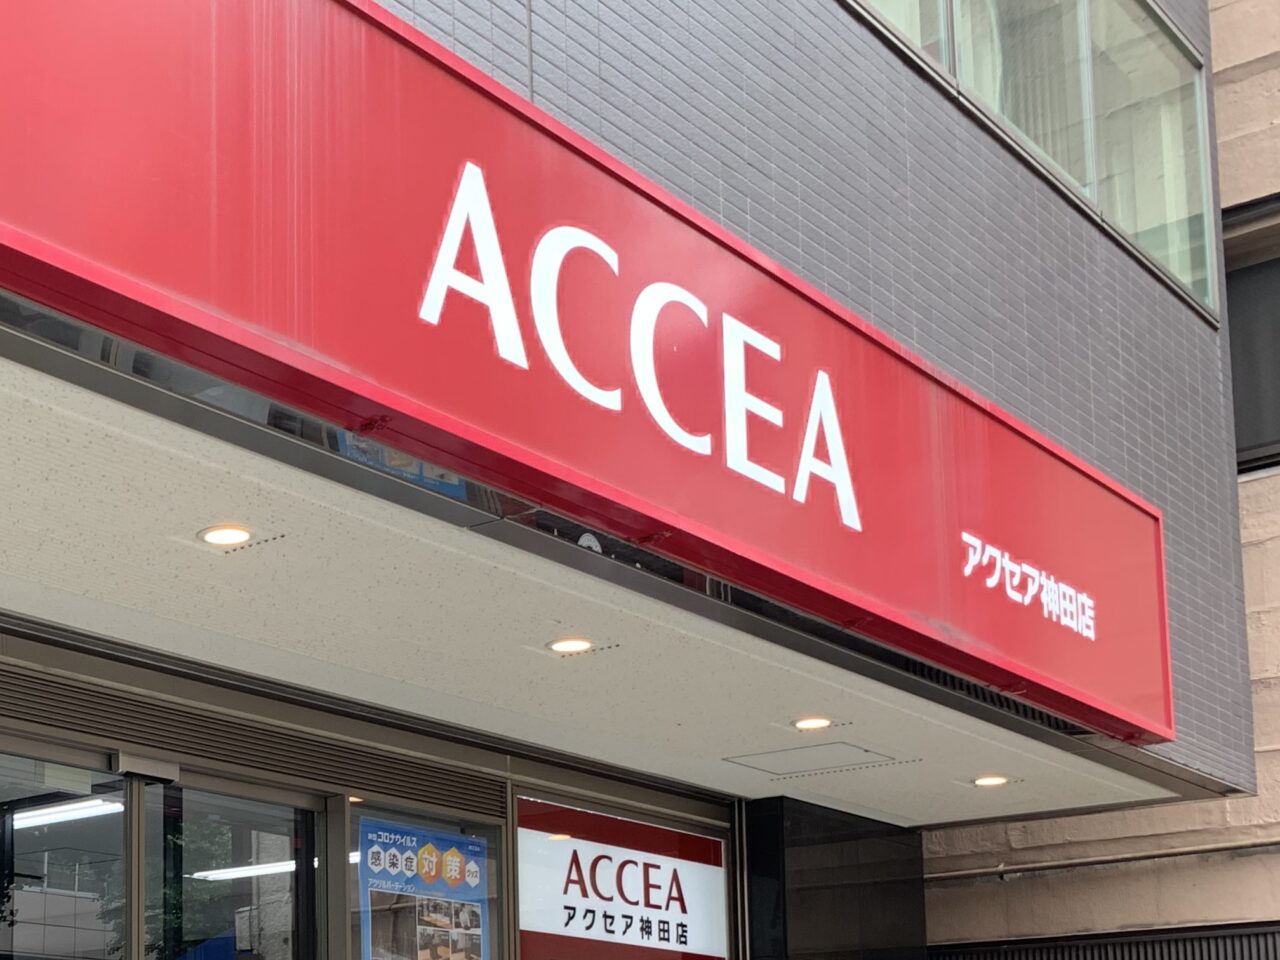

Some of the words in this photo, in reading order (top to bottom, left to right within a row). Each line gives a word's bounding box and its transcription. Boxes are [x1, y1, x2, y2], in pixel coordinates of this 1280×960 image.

[419, 161, 862, 532] ACCEA
[961, 531, 1096, 641] アクセア神田店
[563, 849, 688, 914] ACCEA
[564, 905, 688, 946] アクセア神田店
